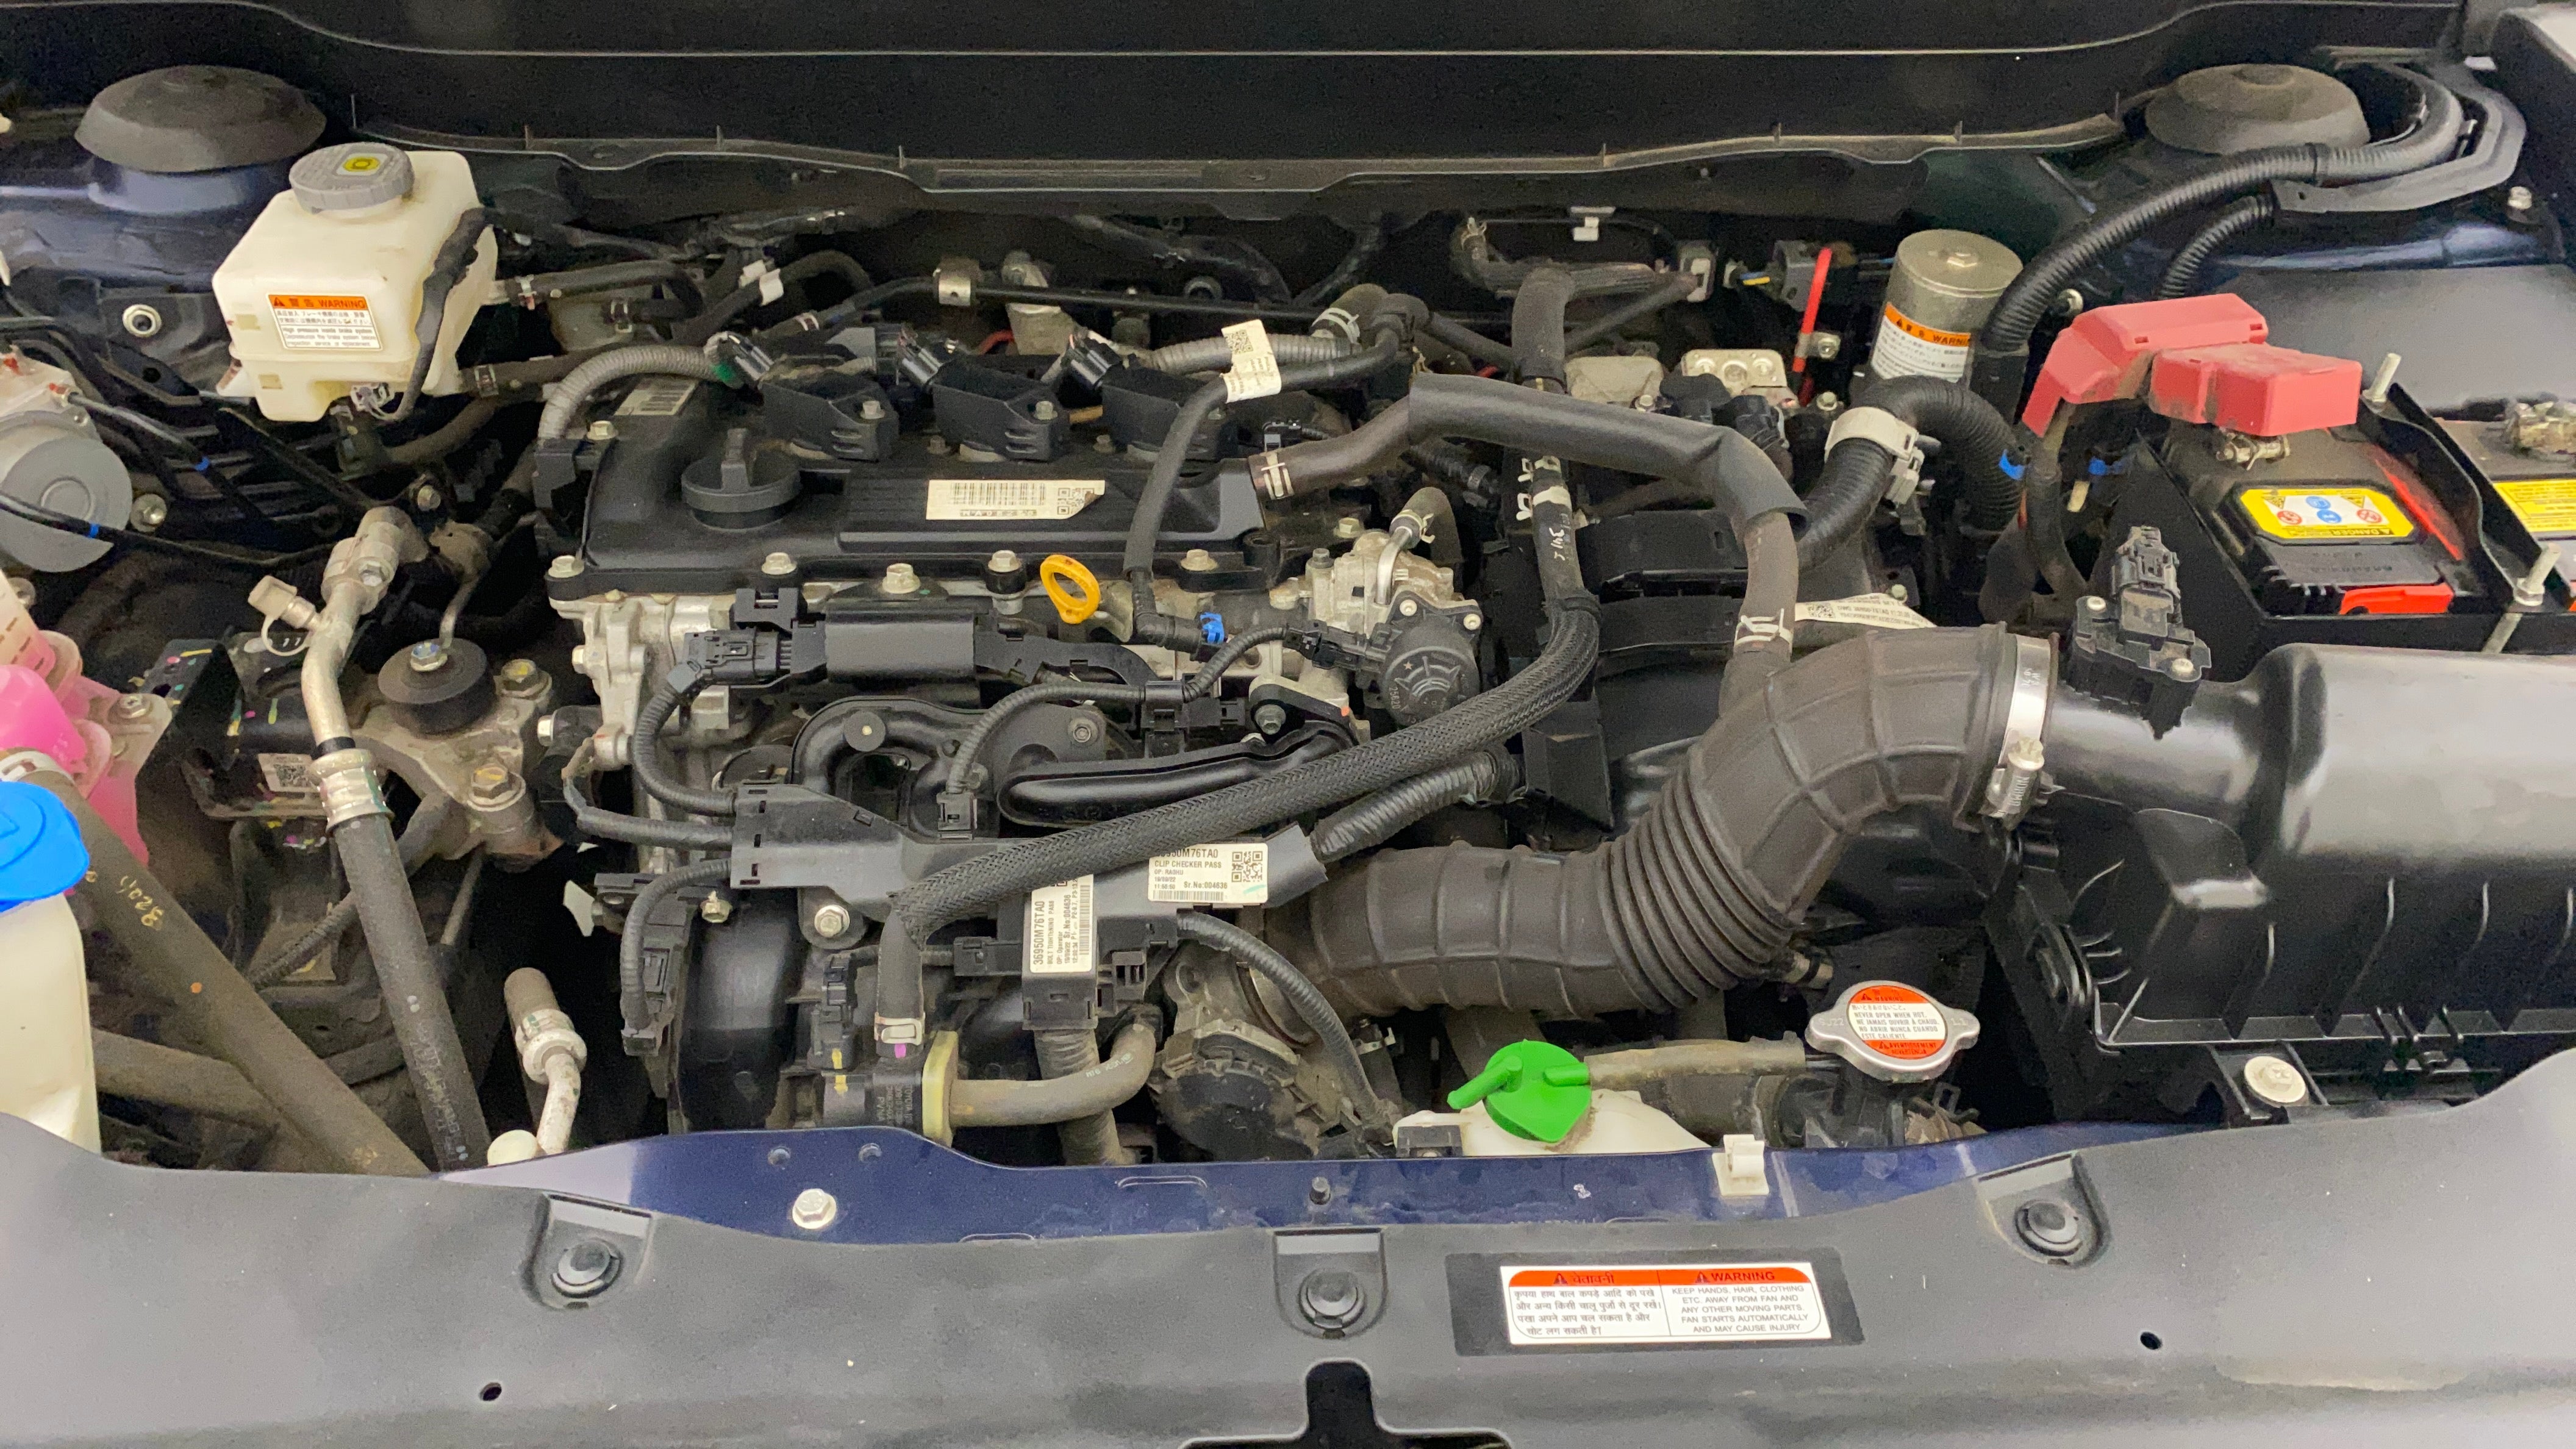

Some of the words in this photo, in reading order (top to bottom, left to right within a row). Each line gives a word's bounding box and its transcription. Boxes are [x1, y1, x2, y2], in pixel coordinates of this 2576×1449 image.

[318, 299, 365, 309] WARNING
[1033, 901, 1045, 965] 36950M76TA0
[1711, 1272, 1775, 1281] WARNING
[1514, 1290, 1537, 1300] कृपया
[1580, 1289, 1599, 1298] कपड़े
[1604, 1288, 1622, 1297] आदि
[1626, 1288, 1637, 1297] को
[1516, 1301, 1530, 1310] और
[1555, 1300, 1575, 1310] किसी
[1580, 1302, 1597, 1312] चालू
[1619, 1300, 1626, 1309] से
[1630, 1302, 1639, 1311] दूर
[1539, 1313, 1558, 1322] अपने
[1626, 1312, 1633, 1322] है
[1636, 1312, 1650, 1322] और
[1526, 1326, 1542, 1335] चोट
[1564, 1325, 1587, 1334] सकती
